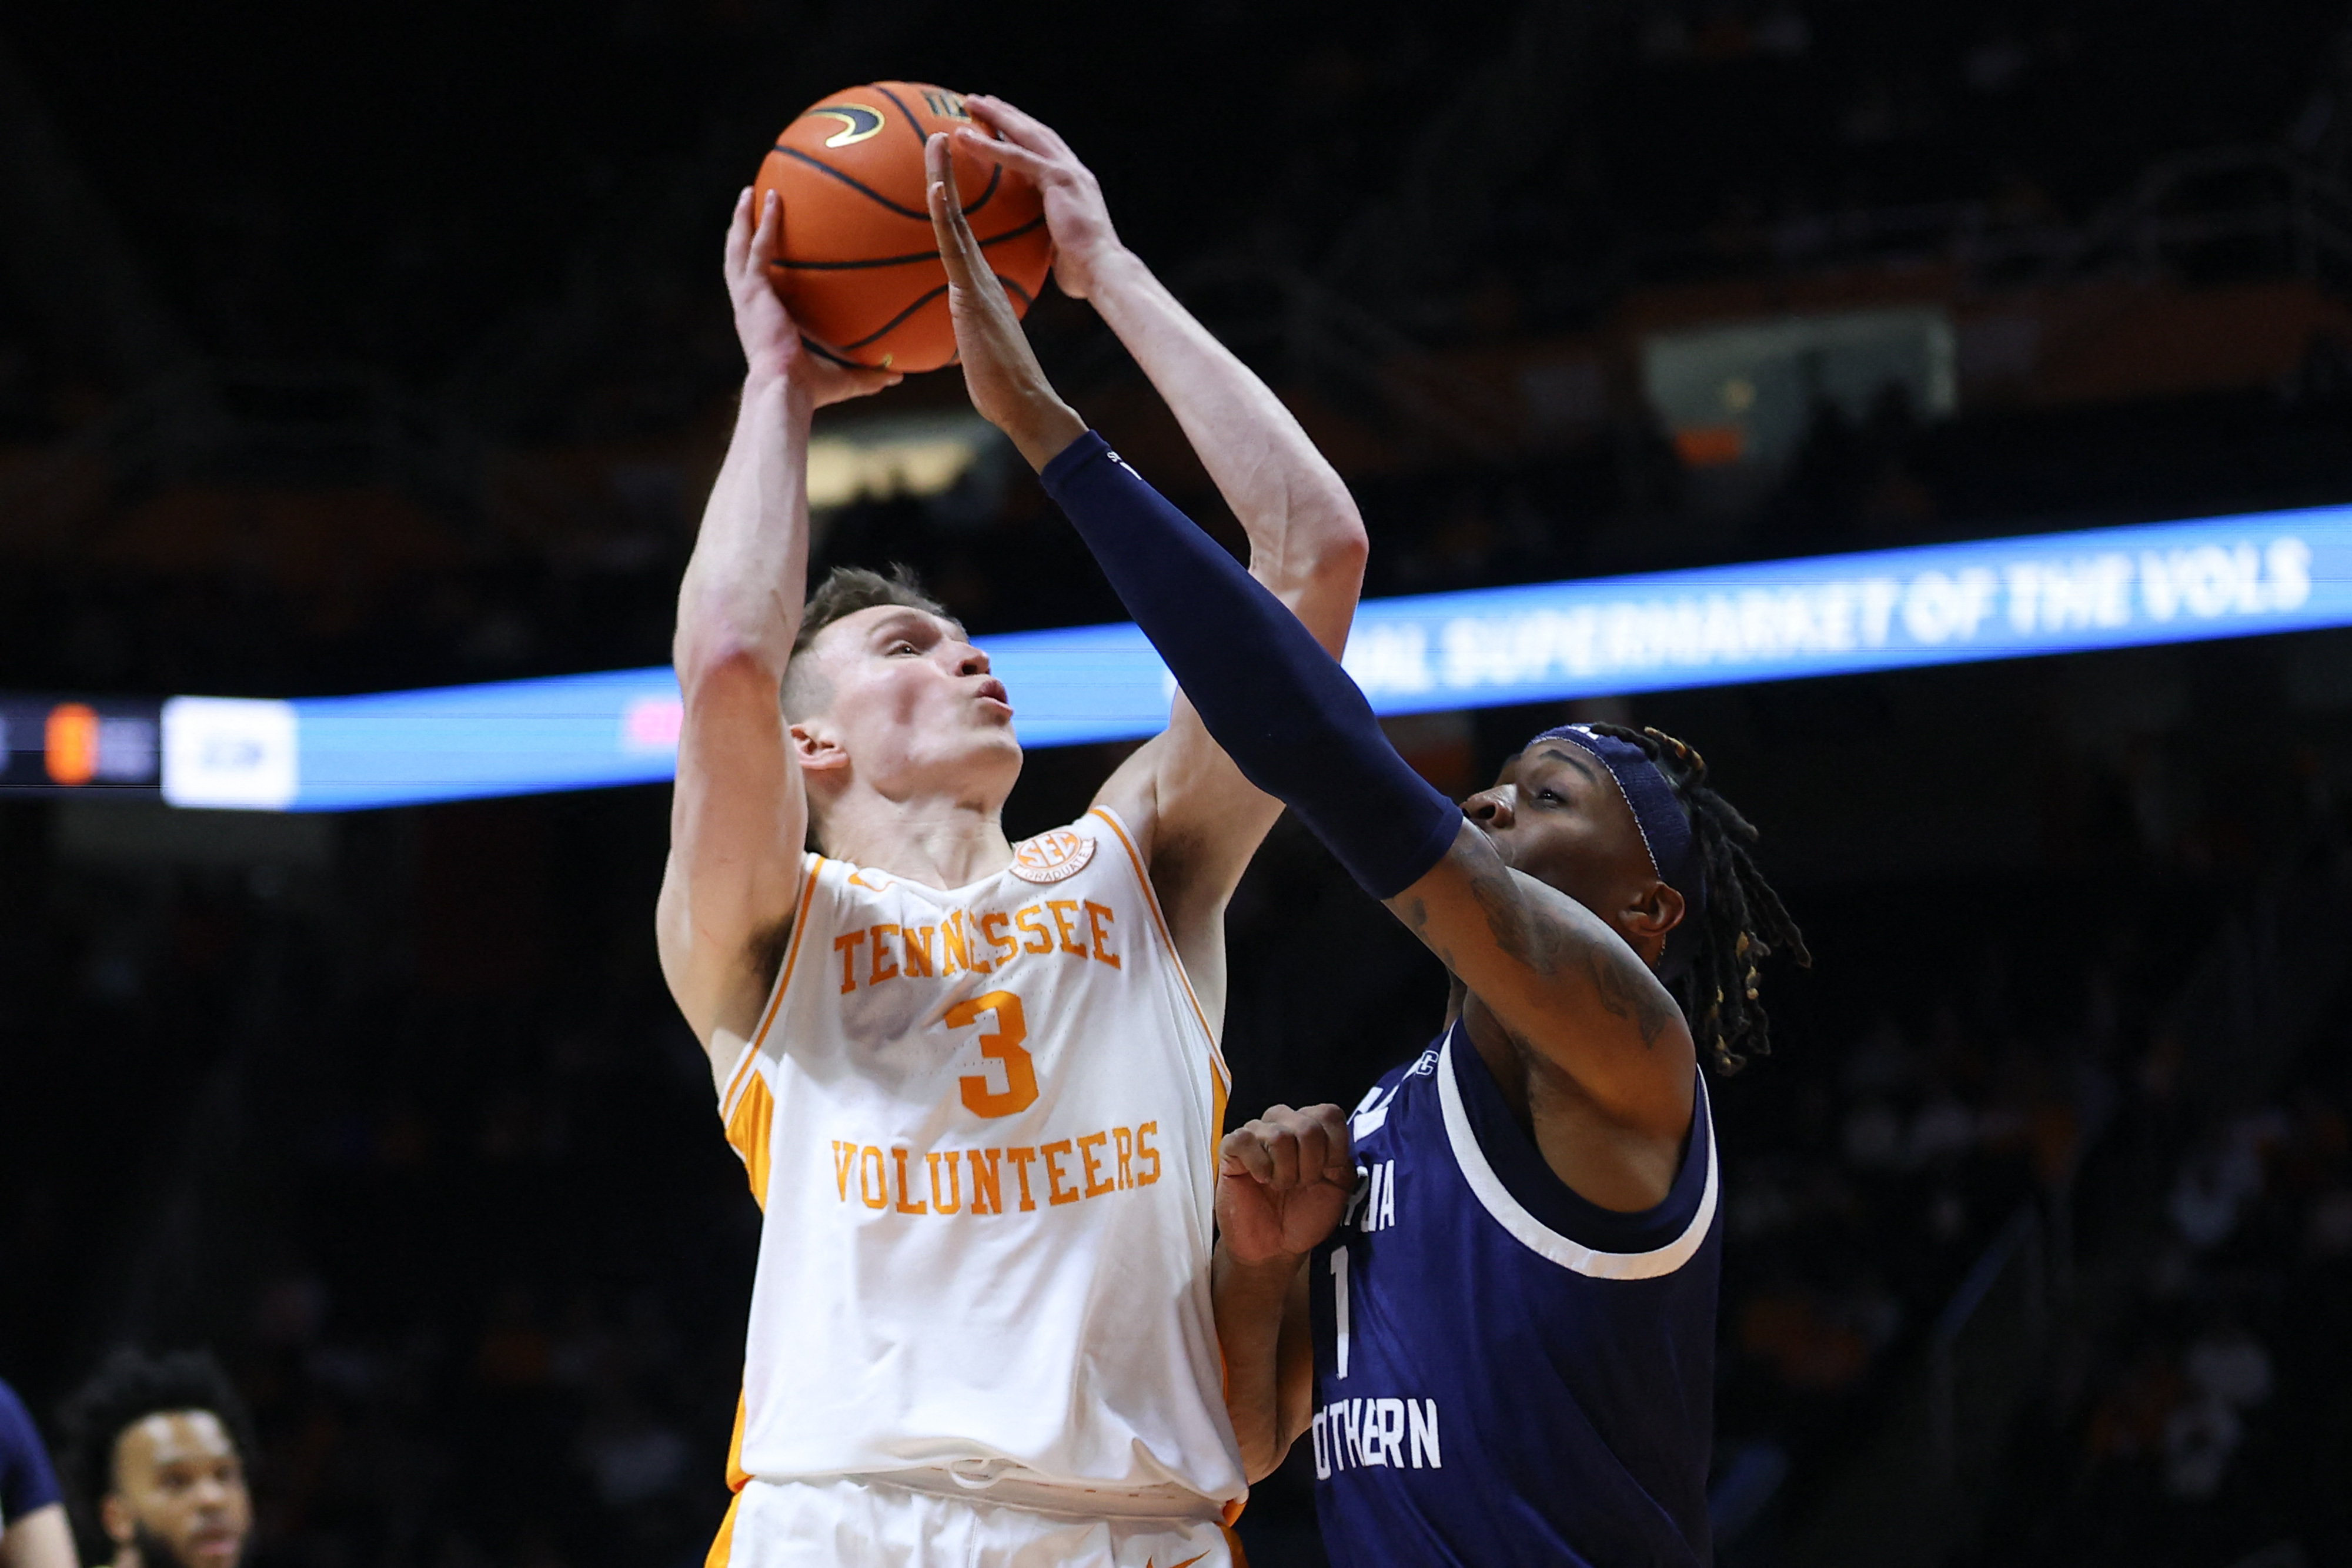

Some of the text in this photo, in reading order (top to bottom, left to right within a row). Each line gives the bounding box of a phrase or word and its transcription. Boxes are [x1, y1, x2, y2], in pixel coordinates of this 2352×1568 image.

[1442, 579, 1899, 689] SUPERMARKET
[1903, 568, 1997, 646] OF
[2004, 551, 2134, 637] THE
[2139, 536, 2313, 624] VOLS
[1019, 832, 1077, 867] SEC
[1025, 851, 1090, 882] GRADUATE
[834, 900, 1121, 994] TENNESSEE
[943, 990, 1038, 1118] 3
[832, 1120, 1161, 1215] VOLUNTEERS
